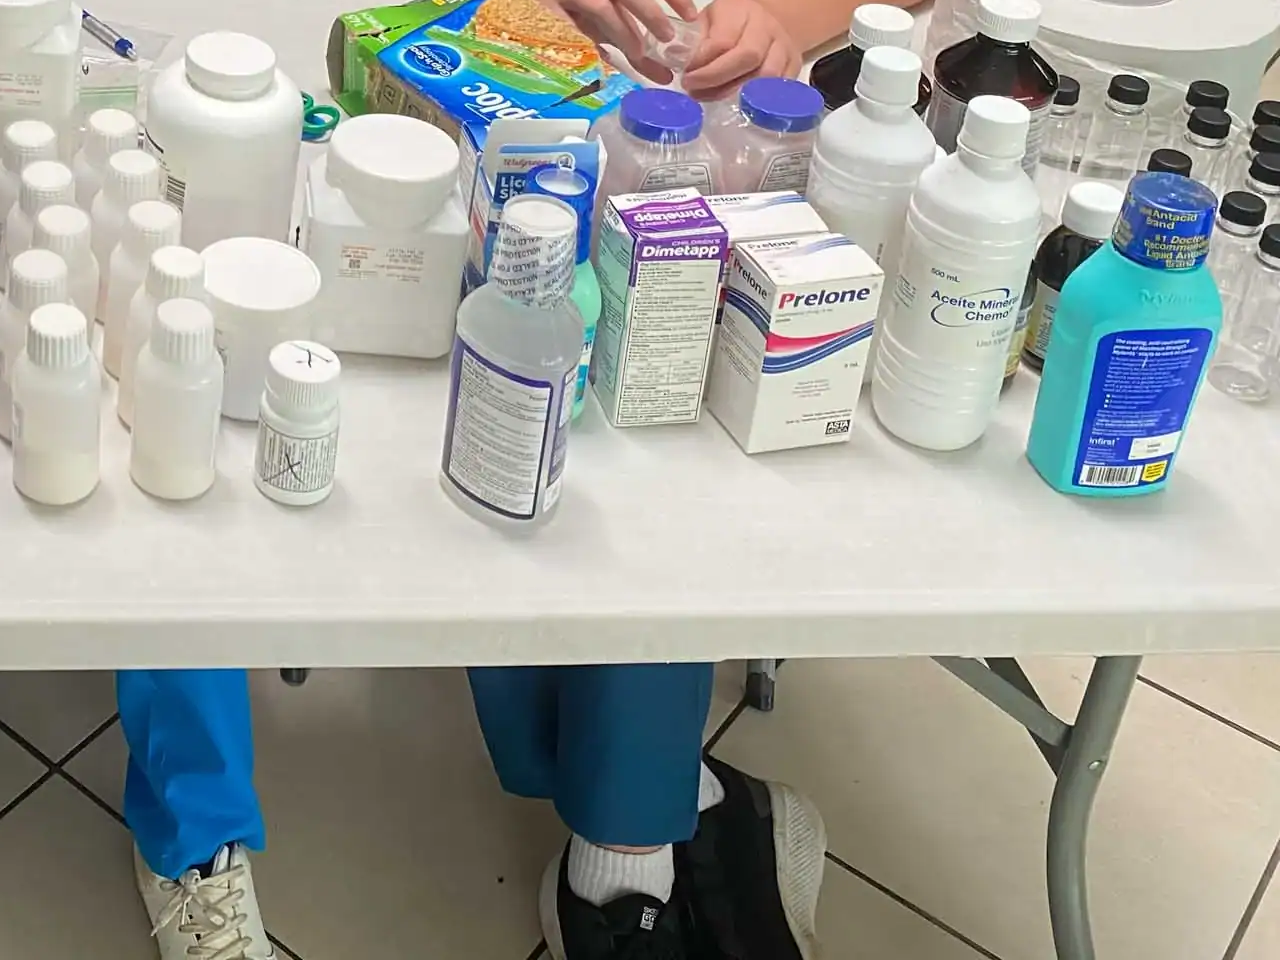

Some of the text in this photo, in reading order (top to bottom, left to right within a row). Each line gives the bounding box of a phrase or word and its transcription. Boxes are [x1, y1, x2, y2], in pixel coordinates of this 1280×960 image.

[705, 195, 752, 203] relone
[634, 208, 709, 223] Dimetapp
[1152, 209, 1199, 222] Antacid
[747, 241, 800, 249] Prelone
[641, 245, 720, 259] Dimetapp
[1146, 248, 1173, 260] Liquid
[733, 258, 769, 299] Prelone
[931, 267, 960, 282] 500 mL
[778, 287, 871, 310] Prelone
[930, 290, 976, 309] Aceite
[965, 310, 1009, 321] Chemo
[828, 420, 849, 428] ASTA
